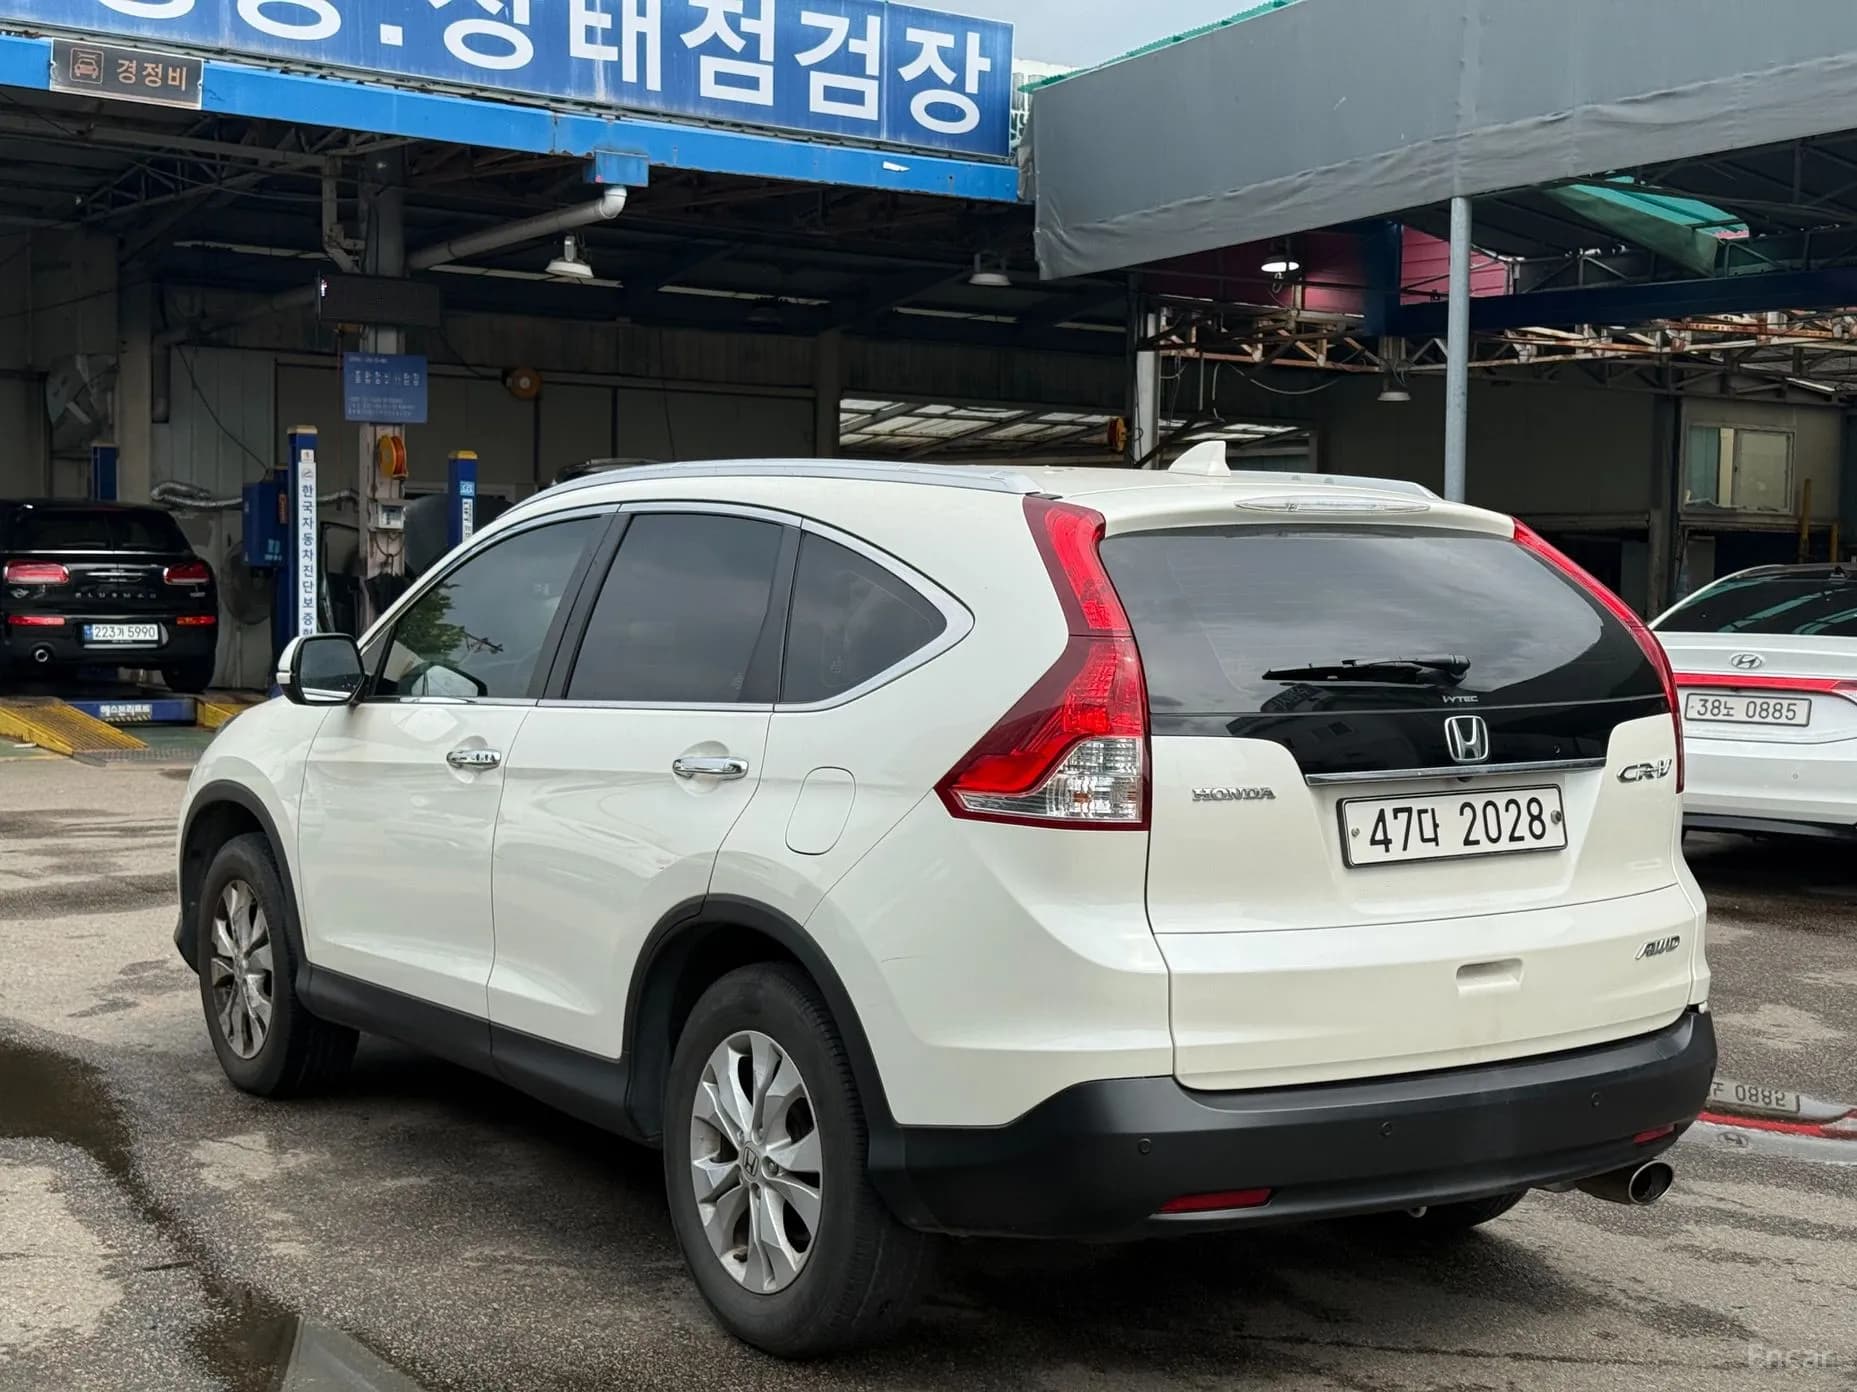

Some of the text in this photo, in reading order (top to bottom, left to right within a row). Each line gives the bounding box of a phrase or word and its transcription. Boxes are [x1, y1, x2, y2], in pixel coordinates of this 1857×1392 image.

[97, 0, 991, 134] .상태점검장
[116, 59, 187, 91] 경정비
[127, 625, 156, 638] 5990
[1696, 698, 1797, 721] 38노 0885
[1616, 759, 1673, 783] CR-V
[1192, 787, 1276, 801] HONDA
[1369, 797, 1547, 853] 47다 2028
[1634, 935, 1681, 960] AWD
